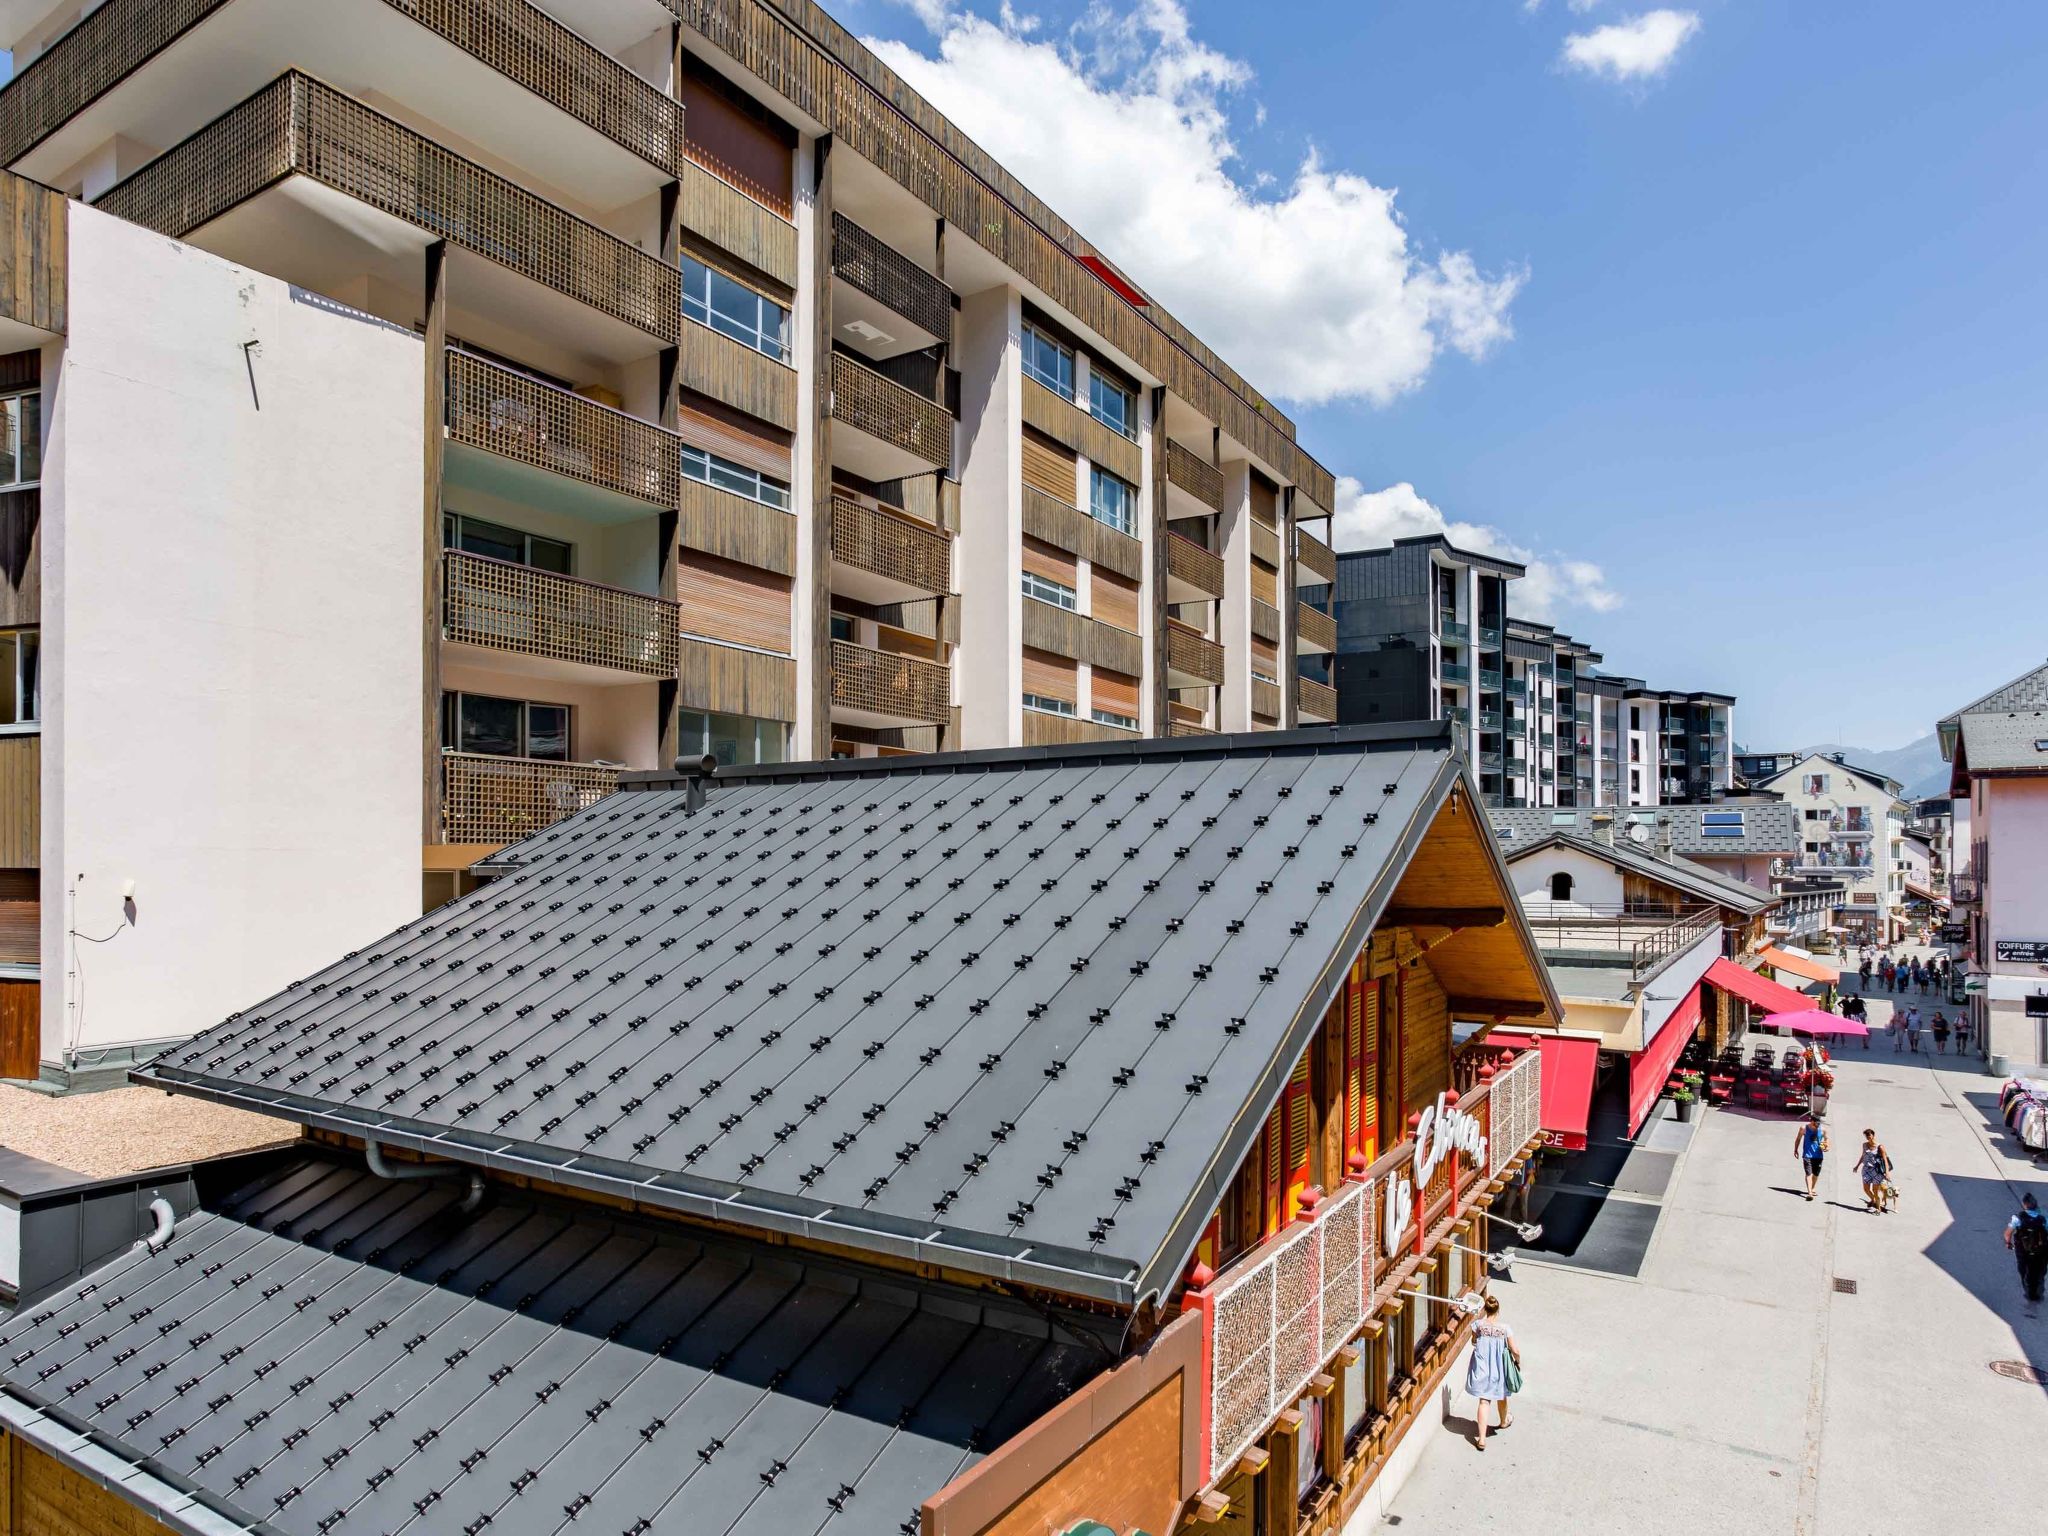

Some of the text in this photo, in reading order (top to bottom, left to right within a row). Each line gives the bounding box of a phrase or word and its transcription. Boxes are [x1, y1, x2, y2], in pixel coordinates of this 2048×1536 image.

[1997, 942, 2035, 951] COIFFURE
[2038, 987, 2048, 996] L
[1385, 1170, 1412, 1259] Le
